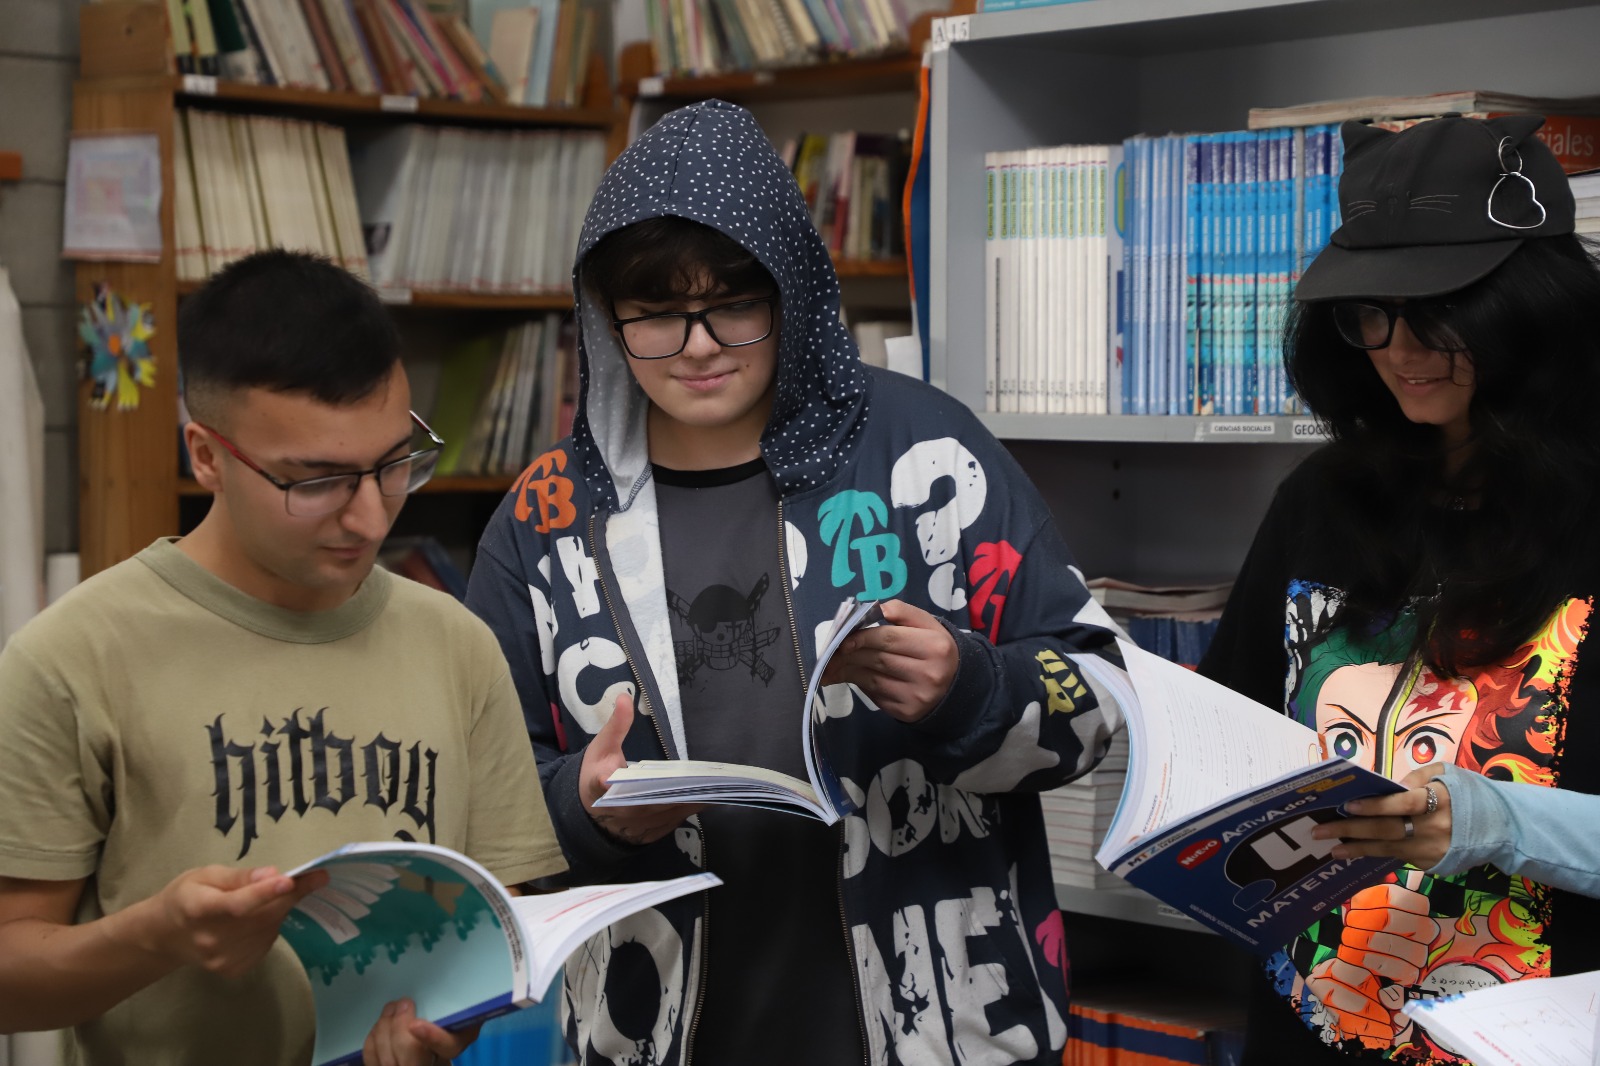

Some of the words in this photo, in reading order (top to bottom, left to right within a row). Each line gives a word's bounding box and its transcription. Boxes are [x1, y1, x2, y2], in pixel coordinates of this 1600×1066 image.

[204, 706, 439, 861] hitboy
[1128, 845, 1157, 867] MTZ
[1250, 815, 1345, 871] 4
